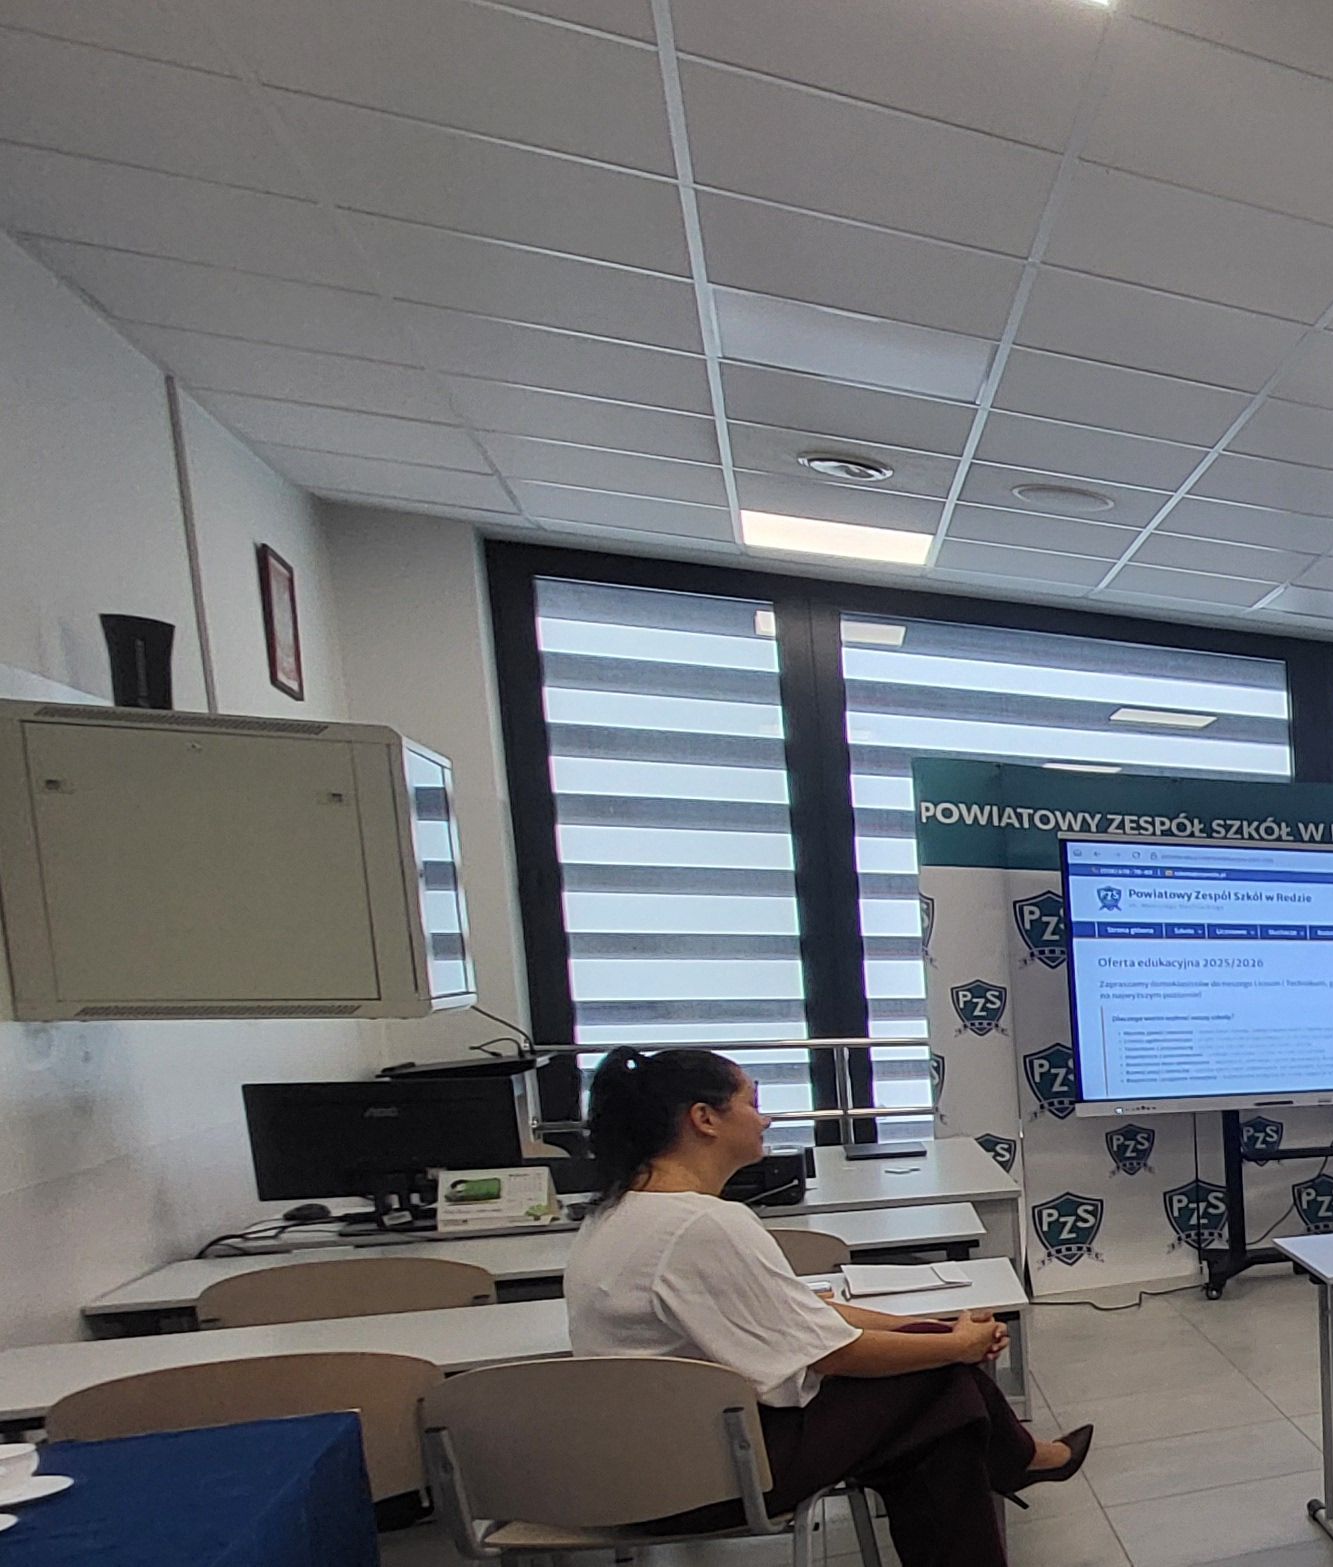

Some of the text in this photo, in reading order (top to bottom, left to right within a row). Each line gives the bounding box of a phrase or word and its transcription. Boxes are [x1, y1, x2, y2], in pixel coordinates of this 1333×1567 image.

[920, 801, 1102, 833] POWIATOWY
[1106, 812, 1207, 837] ZESPÓŁ
[1211, 817, 1294, 841] SZKÓŁ
[1299, 823, 1324, 842] W
[1128, 888, 1192, 902] Powiatowy
[1265, 894, 1275, 902] w
[1276, 892, 1312, 903] Redzie
[1023, 905, 1065, 941] PZ
[1097, 957, 1264, 971] Oferta edukacyjna 2025/2026
[958, 990, 1001, 1016] PZS
[1033, 1058, 1074, 1093] PZ
[1112, 1132, 1150, 1157] PZS
[1242, 1125, 1279, 1149] PZS
[1041, 1204, 1096, 1240] PZS
[1171, 1190, 1227, 1225] PZS
